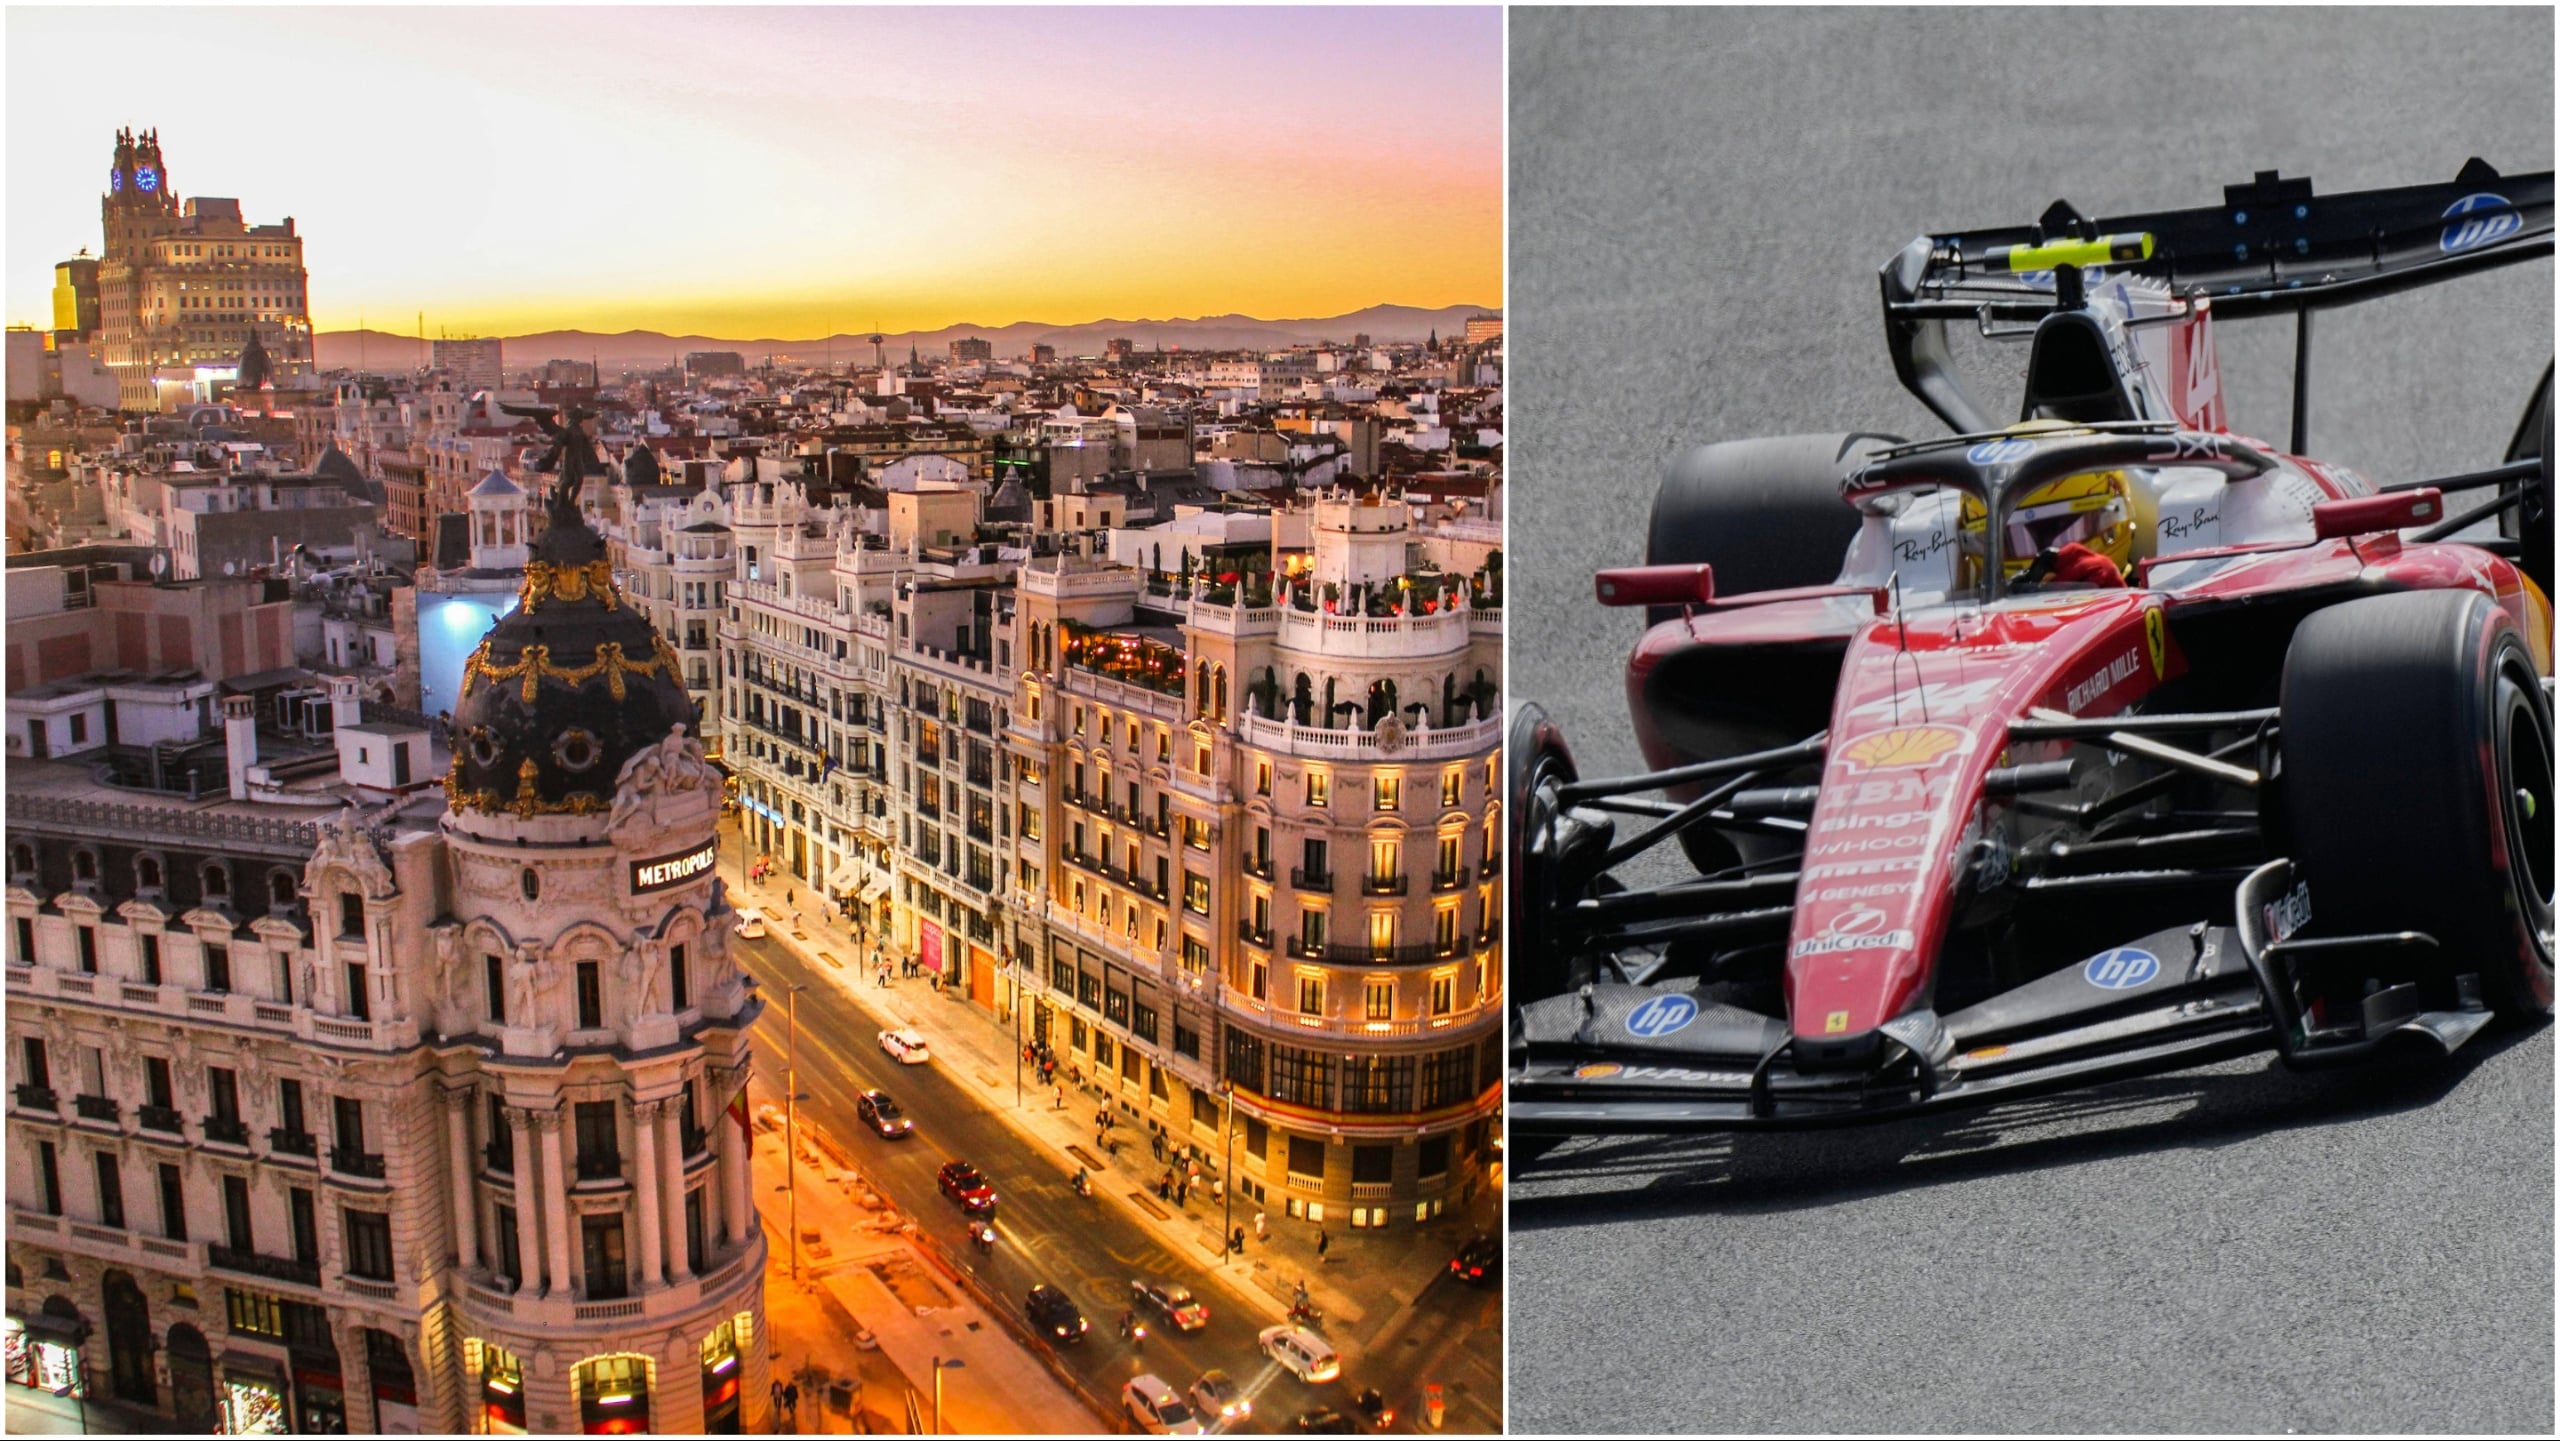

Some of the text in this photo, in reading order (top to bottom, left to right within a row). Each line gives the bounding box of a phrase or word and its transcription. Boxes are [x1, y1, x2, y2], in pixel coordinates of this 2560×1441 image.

[2448, 195, 2515, 249] hp
[1974, 438, 2032, 466] hp
[2157, 507, 2219, 539] Ray-Ban
[1894, 530, 1957, 562] Ray-Ban
[2067, 647, 2140, 717] RICHARD MILLE
[1848, 677, 2004, 722] 44
[1822, 775, 1950, 809] IBM
[638, 846, 714, 887] METROPOLIS
[1804, 856, 1922, 883] PIRELL
[1796, 932, 1906, 954] UniCredi
[2093, 948, 2153, 989] hp
[1631, 994, 1693, 1037] hp
[1622, 1066, 1780, 1084] V-Pow
